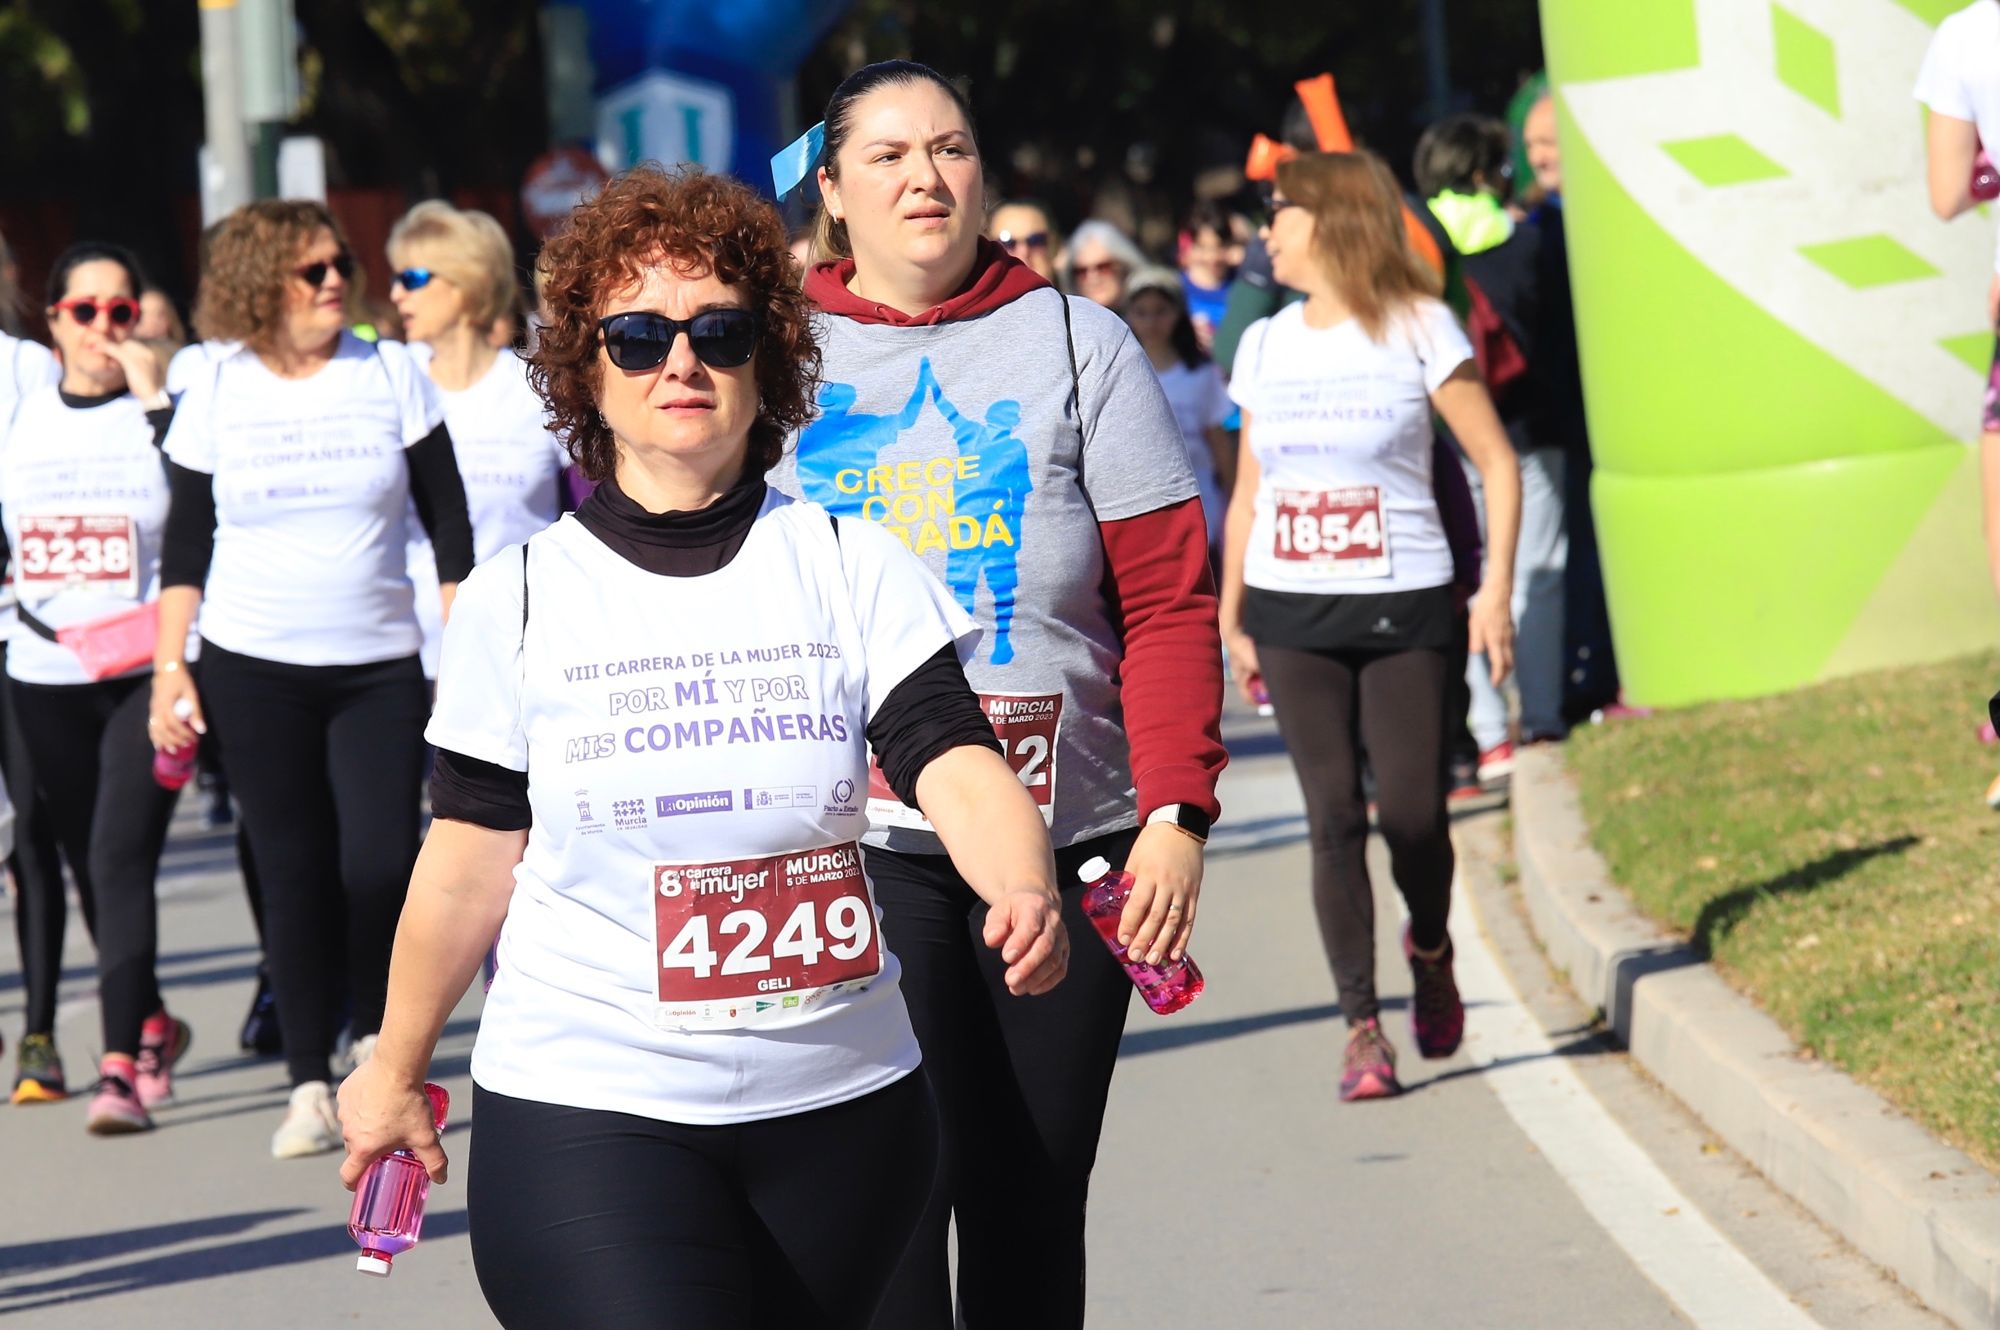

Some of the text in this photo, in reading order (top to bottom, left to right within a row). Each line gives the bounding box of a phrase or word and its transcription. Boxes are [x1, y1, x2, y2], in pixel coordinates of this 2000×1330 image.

[835, 455, 980, 494] CRECE
[862, 488, 956, 524] CON
[1277, 510, 1381, 553] 1854
[22, 536, 130, 574] 3238
[564, 642, 840, 682] VIII CARRERA DE LA MUJER 2023
[609, 670, 809, 716] POR MÍ Y POR
[989, 700, 1054, 715] MURCIA
[565, 707, 848, 764] MIS COMPAÑERAS
[995, 716, 1006, 724] DE
[1008, 714, 1034, 724] MARZO
[1035, 713, 1053, 721] 2023
[615, 816, 647, 826] Murcia
[686, 866, 731, 879] carrera
[786, 849, 857, 876] MURCIA
[786, 877, 793, 886] 5
[795, 876, 808, 885] DE
[810, 871, 843, 884] MARZO
[700, 871, 769, 903] mujer
[662, 896, 872, 979] 4249
[757, 976, 791, 992] GELI
